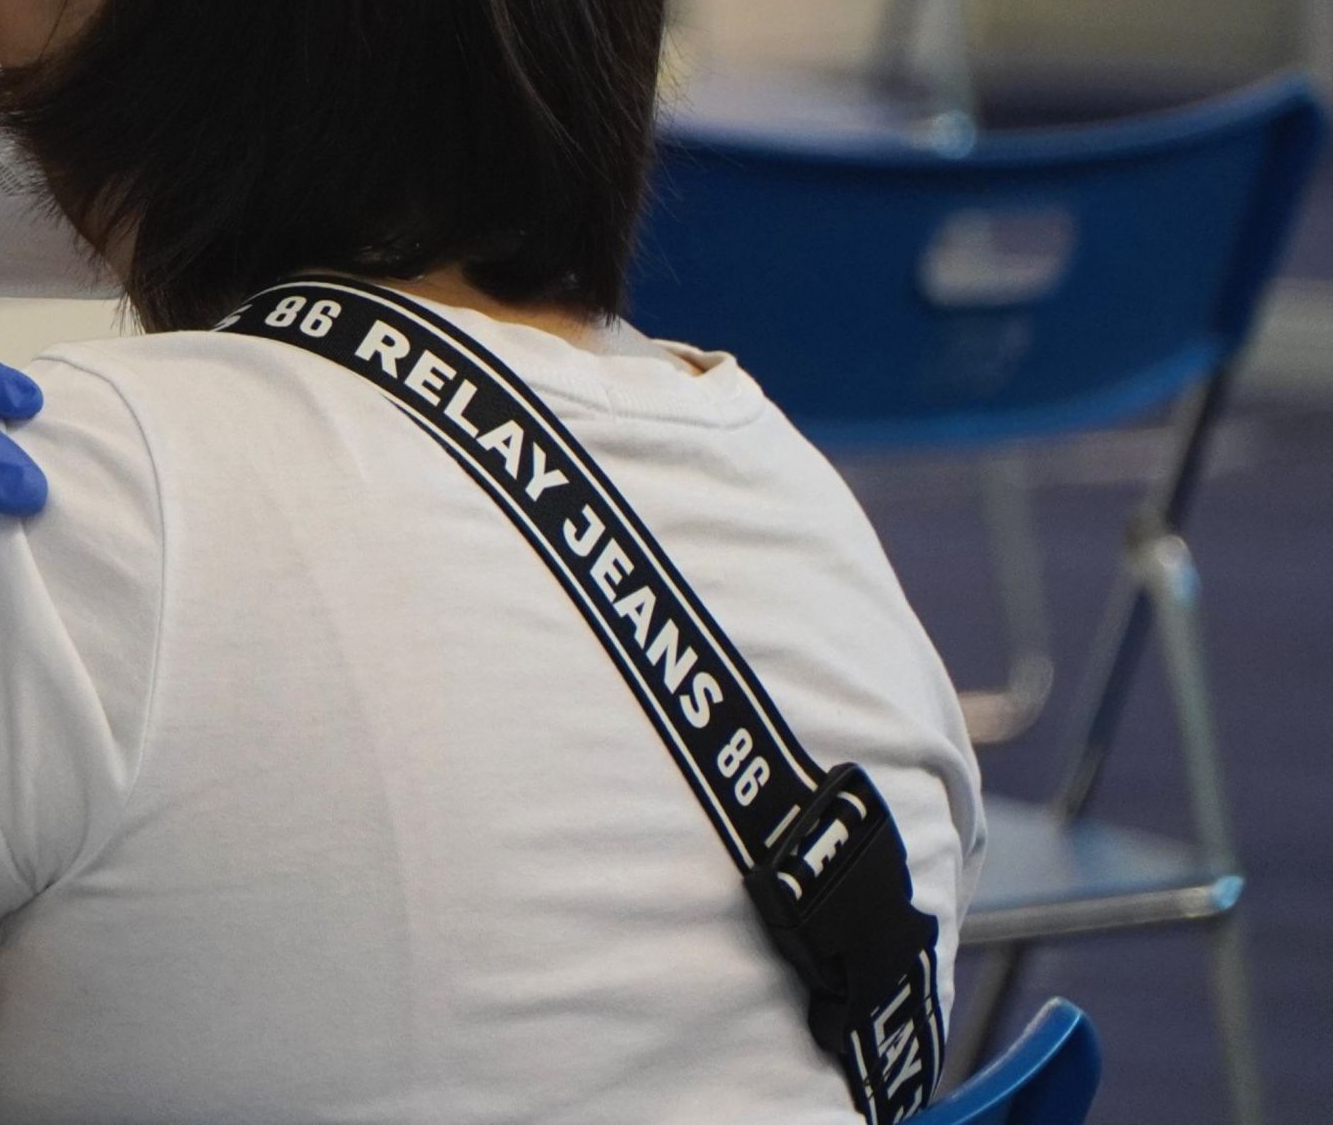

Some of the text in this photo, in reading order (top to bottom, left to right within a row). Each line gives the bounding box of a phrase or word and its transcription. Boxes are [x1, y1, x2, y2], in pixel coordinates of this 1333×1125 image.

[264, 295, 343, 338] 86
[354, 319, 570, 502] RELAY
[562, 503, 724, 729] JEANS
[717, 727, 771, 806] 86
